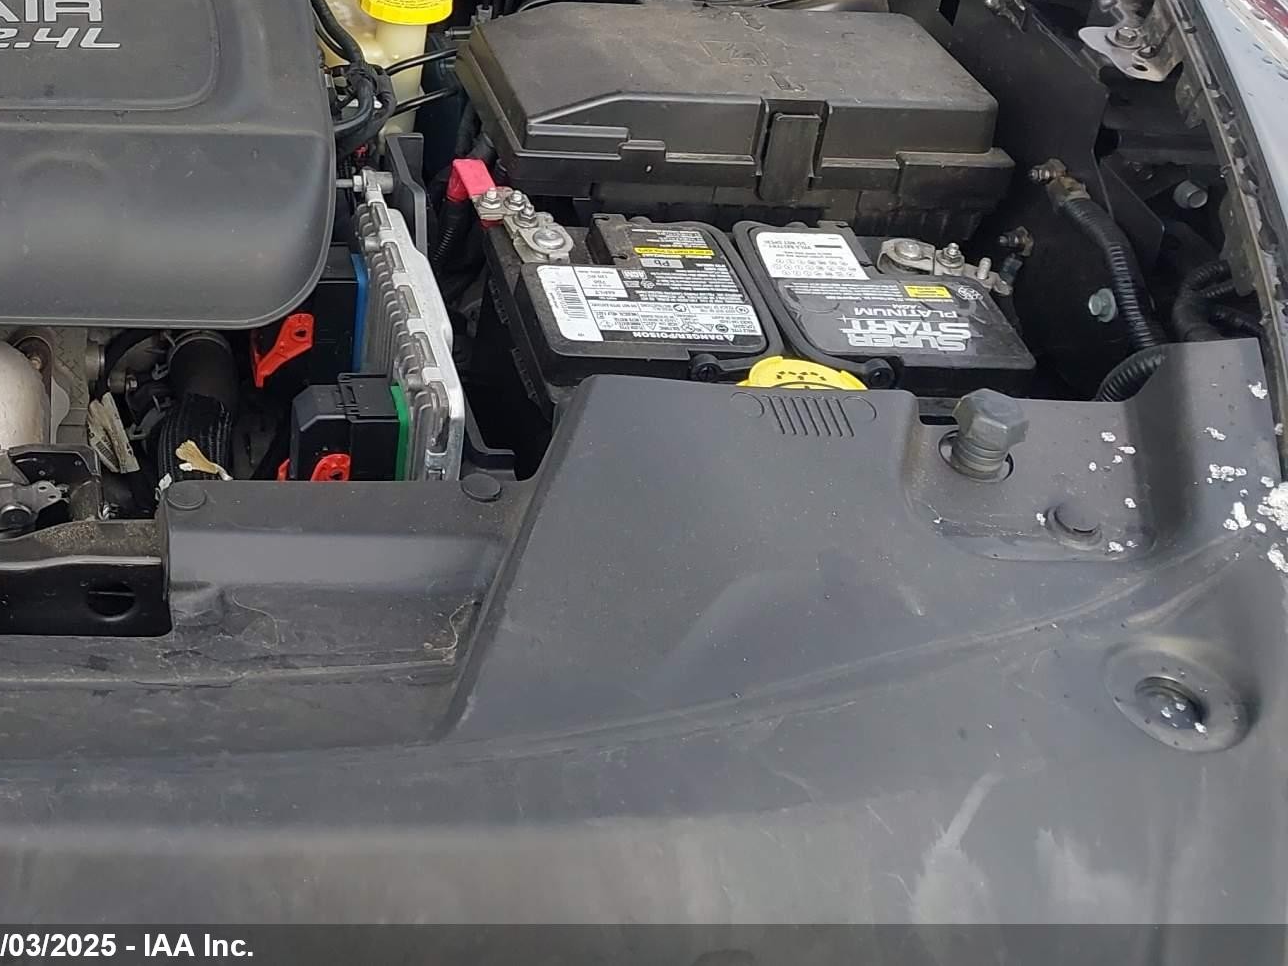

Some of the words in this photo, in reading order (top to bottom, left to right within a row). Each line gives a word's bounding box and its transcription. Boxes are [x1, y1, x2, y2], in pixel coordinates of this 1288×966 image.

[653, 258, 670, 267] Pb
[853, 307, 958, 318] PLATINUM
[840, 320, 971, 339] START
[847, 333, 967, 351] SUPER
